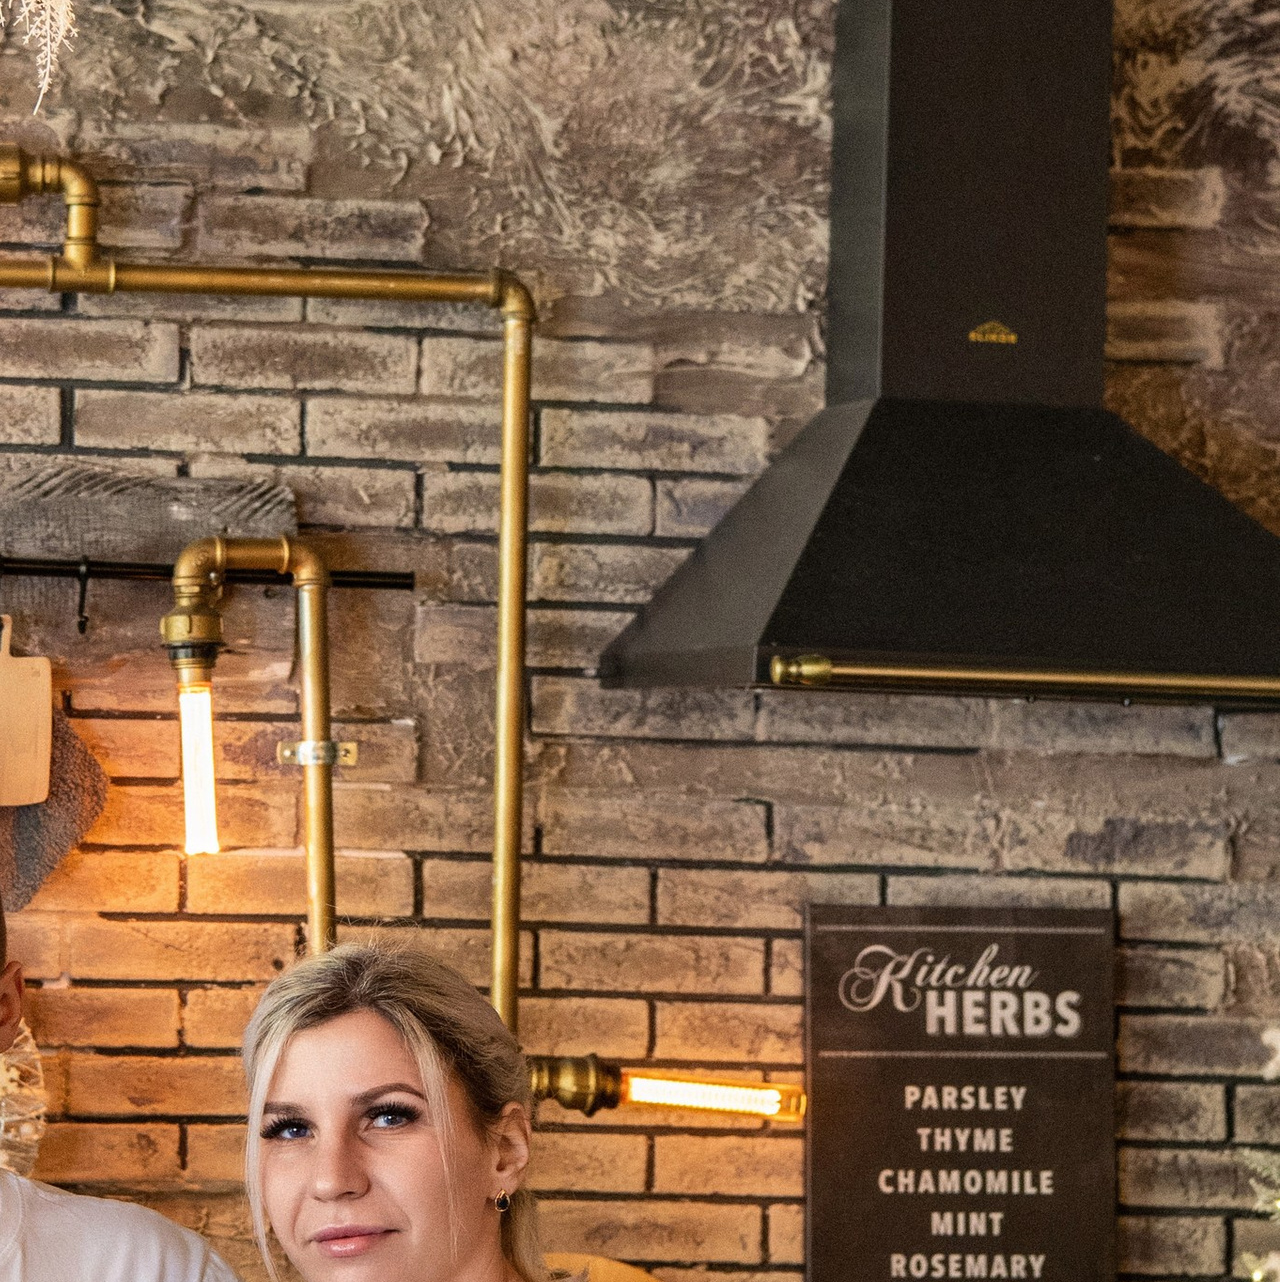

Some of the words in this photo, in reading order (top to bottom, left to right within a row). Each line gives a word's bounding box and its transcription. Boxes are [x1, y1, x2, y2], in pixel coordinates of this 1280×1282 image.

[838, 943, 1039, 1013] Kitchen
[925, 990, 1081, 1038] HERBS
[904, 1085, 1027, 1111] PARSLEY
[917, 1127, 1015, 1153] THYME
[877, 1169, 1054, 1195] CHAMOMILE
[930, 1211, 1005, 1237] MINT
[890, 1253, 1046, 1279] ROSEMARY
